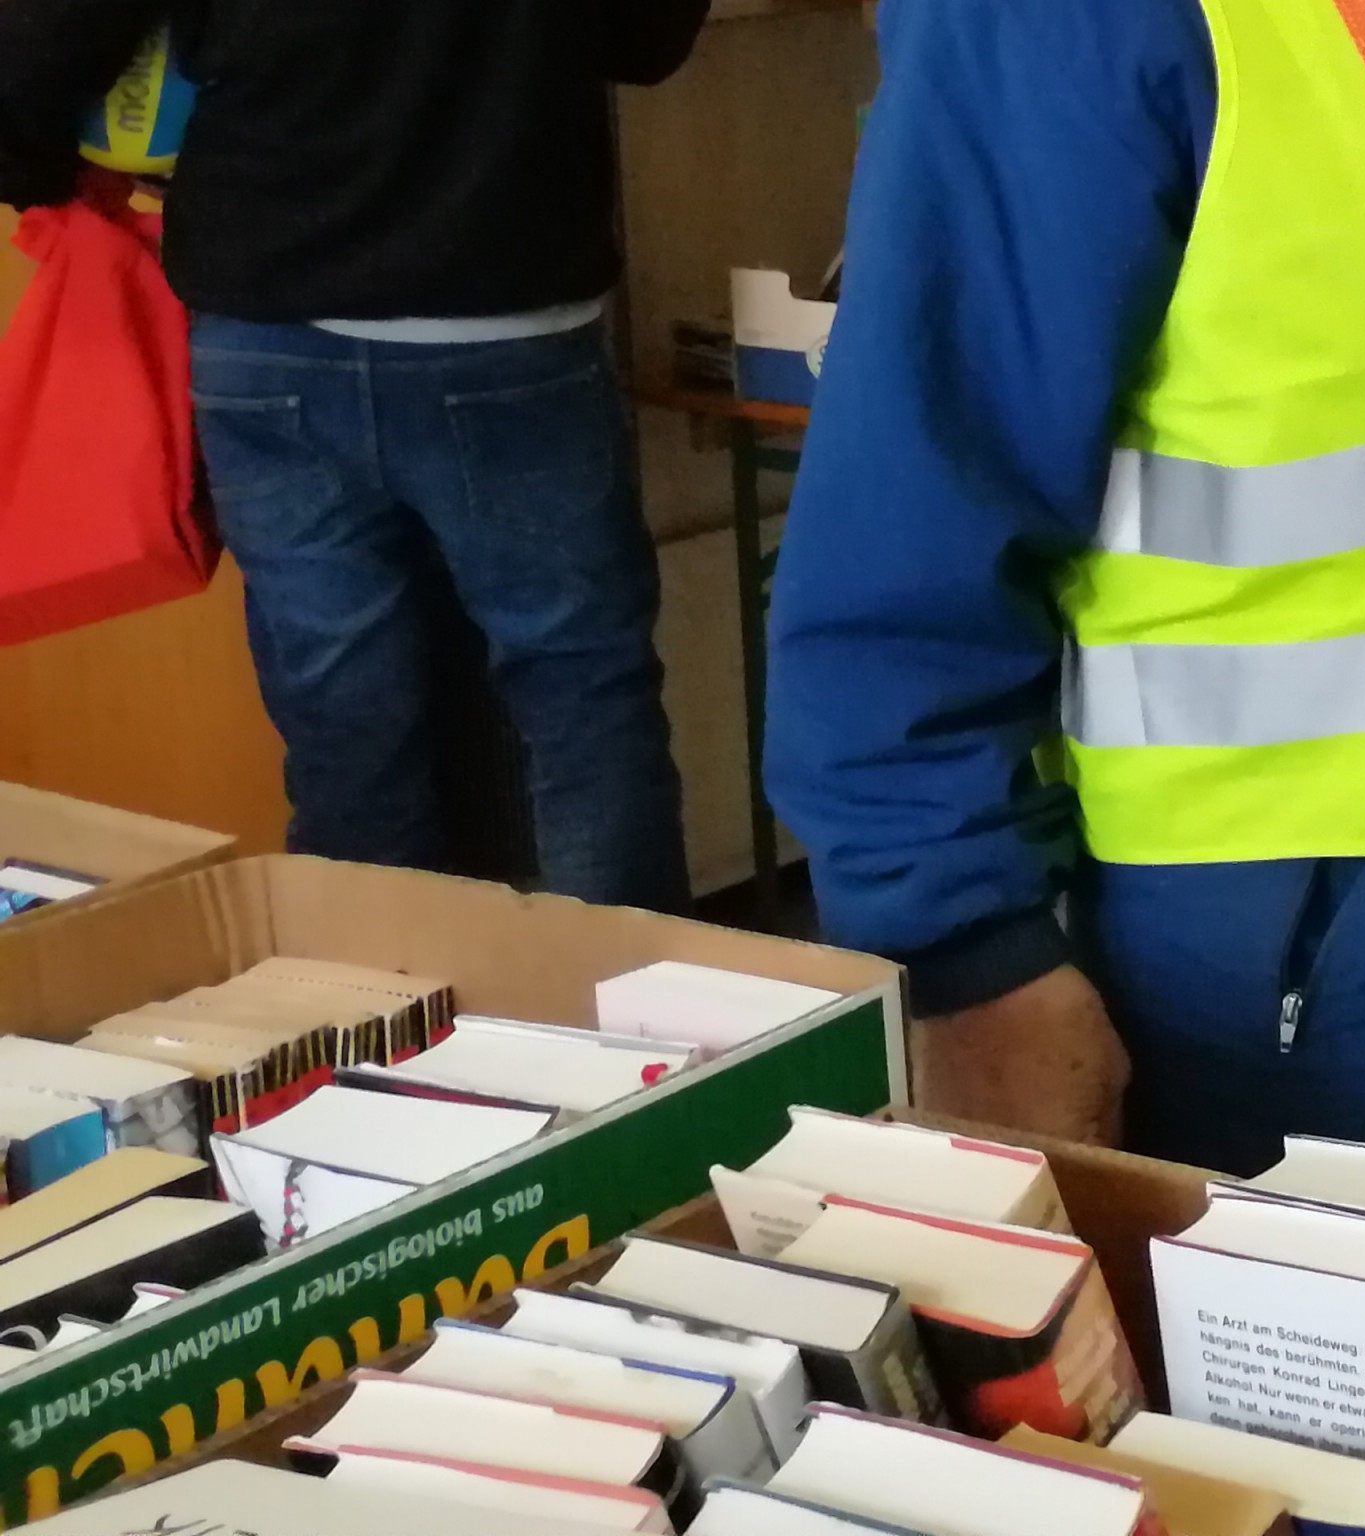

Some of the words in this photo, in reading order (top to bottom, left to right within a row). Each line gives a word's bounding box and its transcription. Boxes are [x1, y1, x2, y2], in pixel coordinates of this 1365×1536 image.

[491, 1172, 545, 1224] aus
[291, 1207, 483, 1312] biologischer
[1197, 1309, 1218, 1325] Ein
[1222, 1315, 1248, 1331] Arzt
[1252, 1324, 1272, 1336] am
[1200, 1330, 1251, 1352] hängnis
[1255, 1343, 1280, 1359] des
[7, 1296, 282, 1450] Landwirtschaft
[1202, 1350, 1266, 1375] Chirurgen
[1272, 1365, 1321, 1388] Konrad
[1207, 1390, 1231, 1406] ken
[1269, 1405, 1301, 1423] kann
[1308, 1417, 1322, 1428] er
[1259, 1382, 1282, 1398] Nur
[1285, 1391, 1321, 1407] wenn
[1322, 1399, 1336, 1411] er
